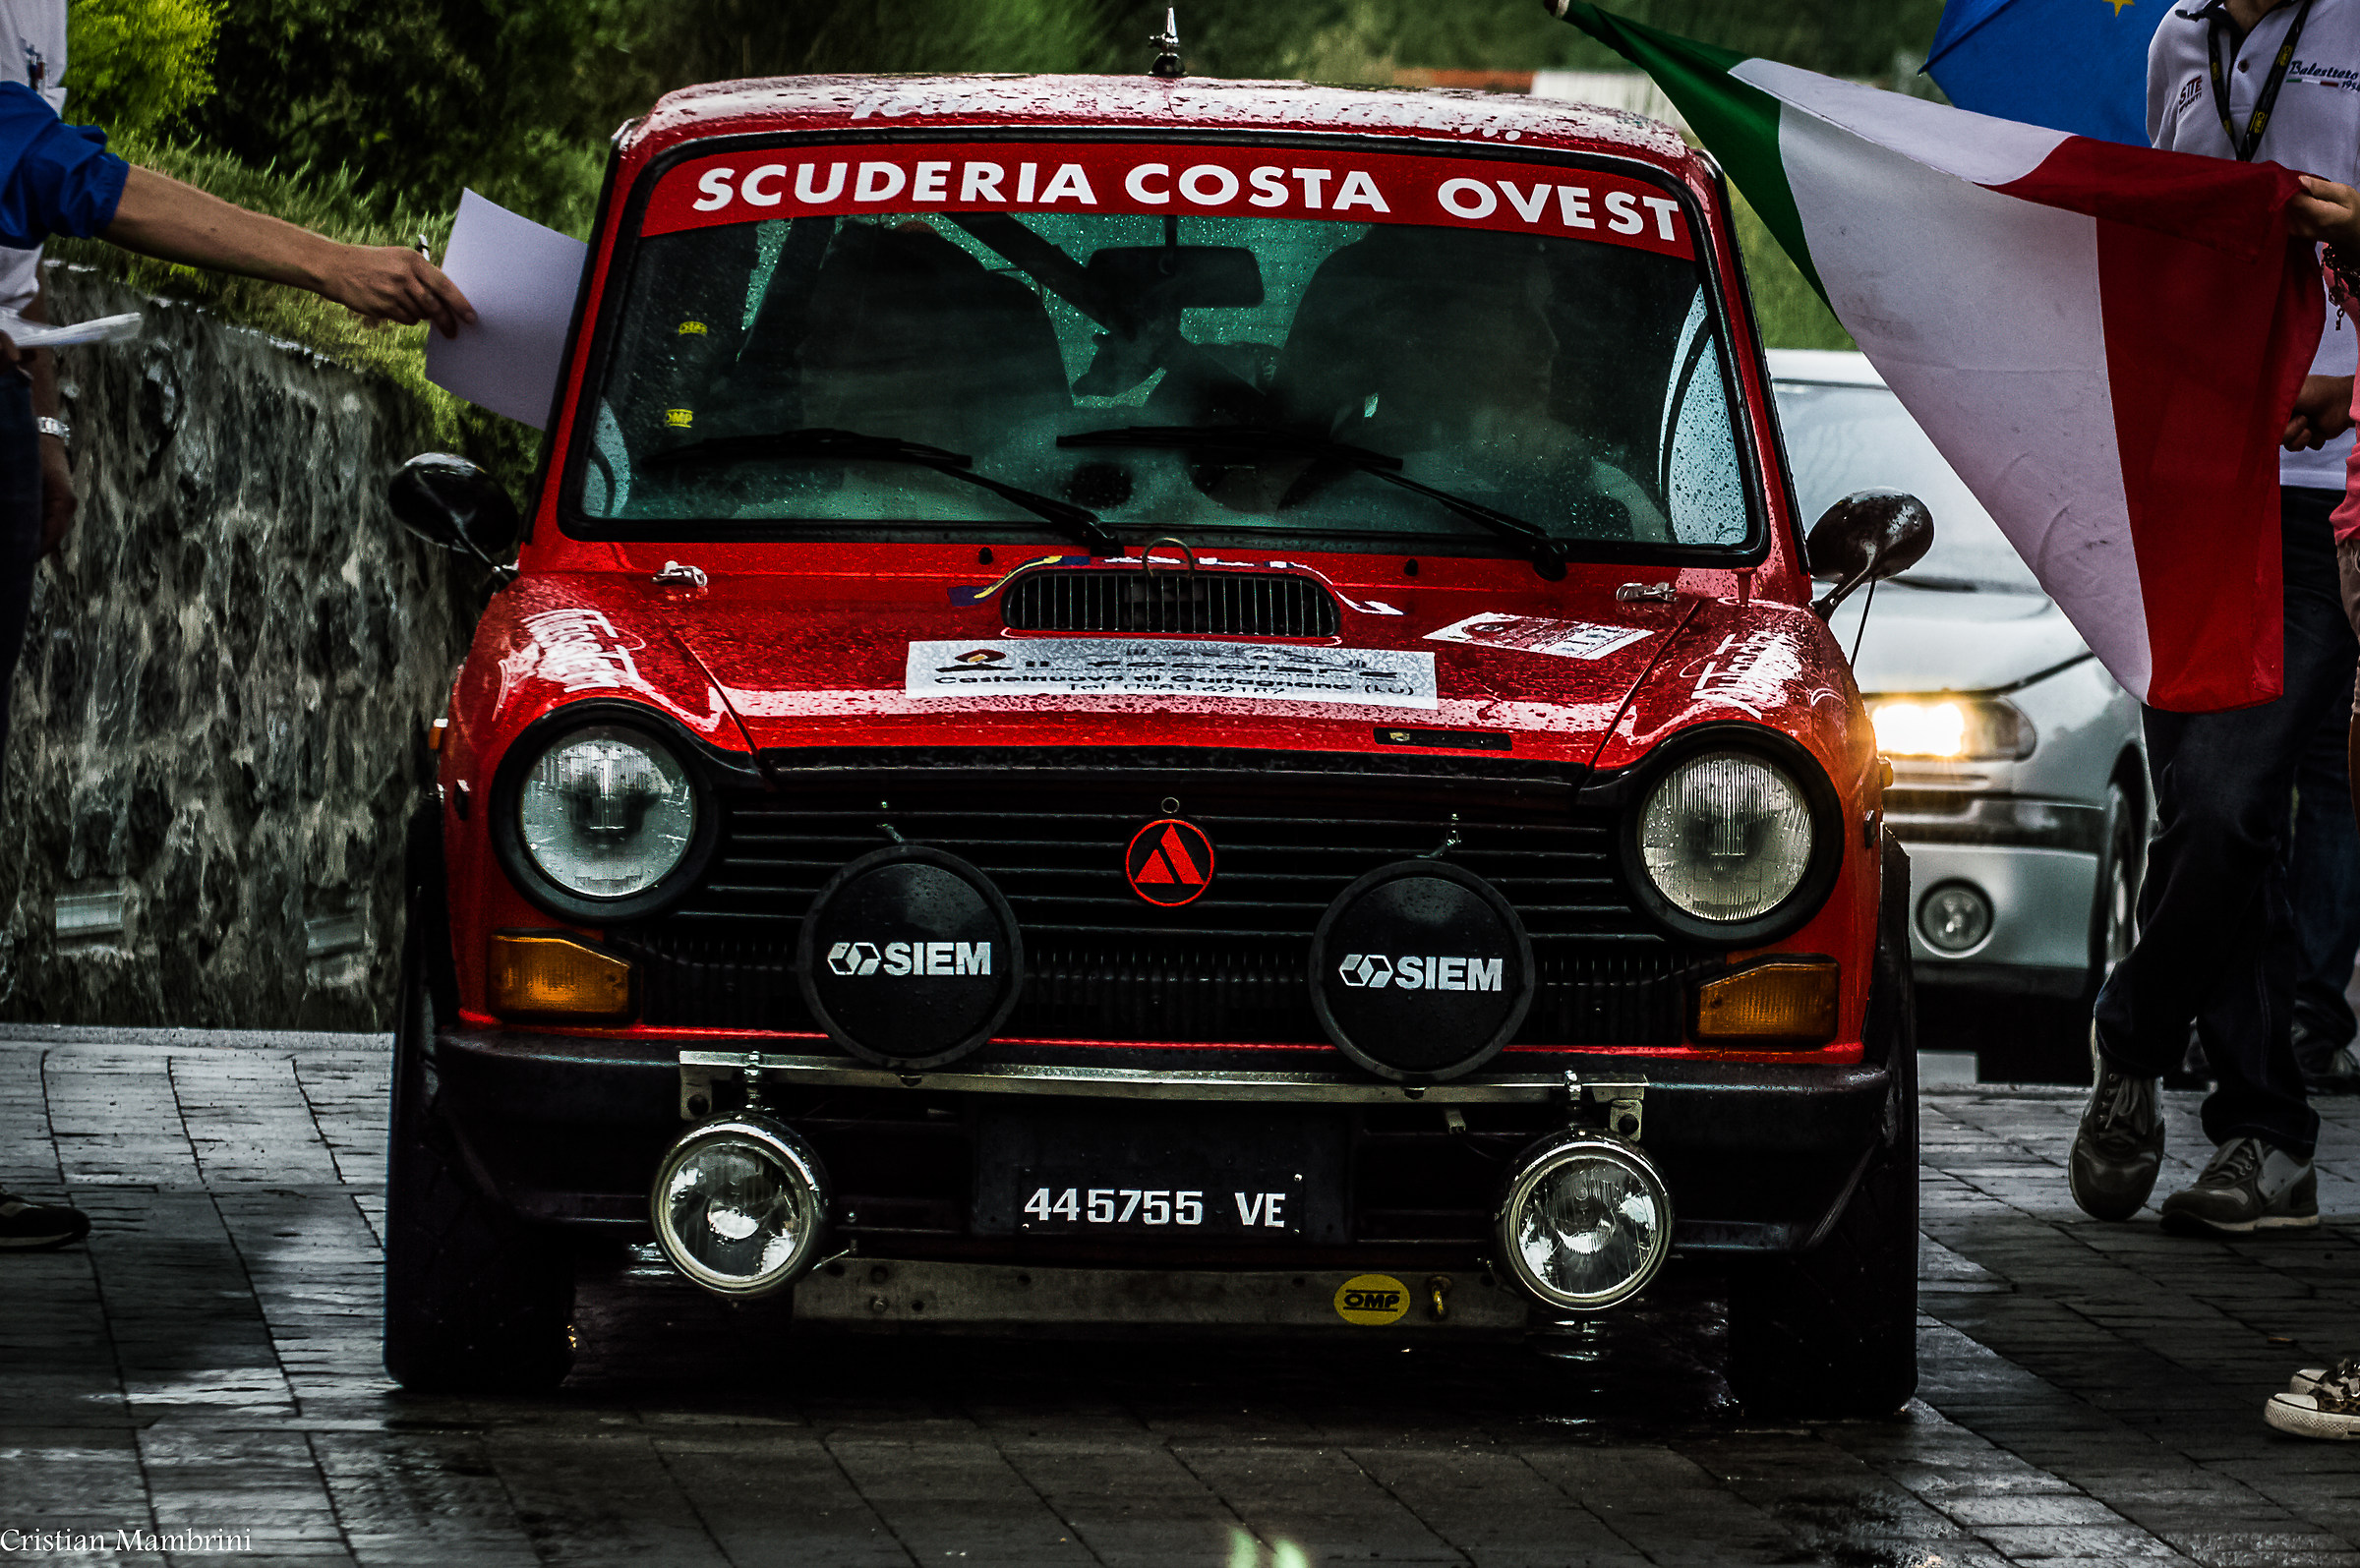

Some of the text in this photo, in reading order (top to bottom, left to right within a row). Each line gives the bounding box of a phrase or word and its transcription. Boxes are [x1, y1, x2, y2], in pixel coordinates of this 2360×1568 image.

[693, 162, 1679, 241] SCUDERIA COSTA OVEST
[884, 942, 991, 976] SIEM
[1395, 957, 1504, 991] SIEM
[1024, 1188, 1286, 1228] 445755 VE
[1343, 1292, 1400, 1309] OMP
